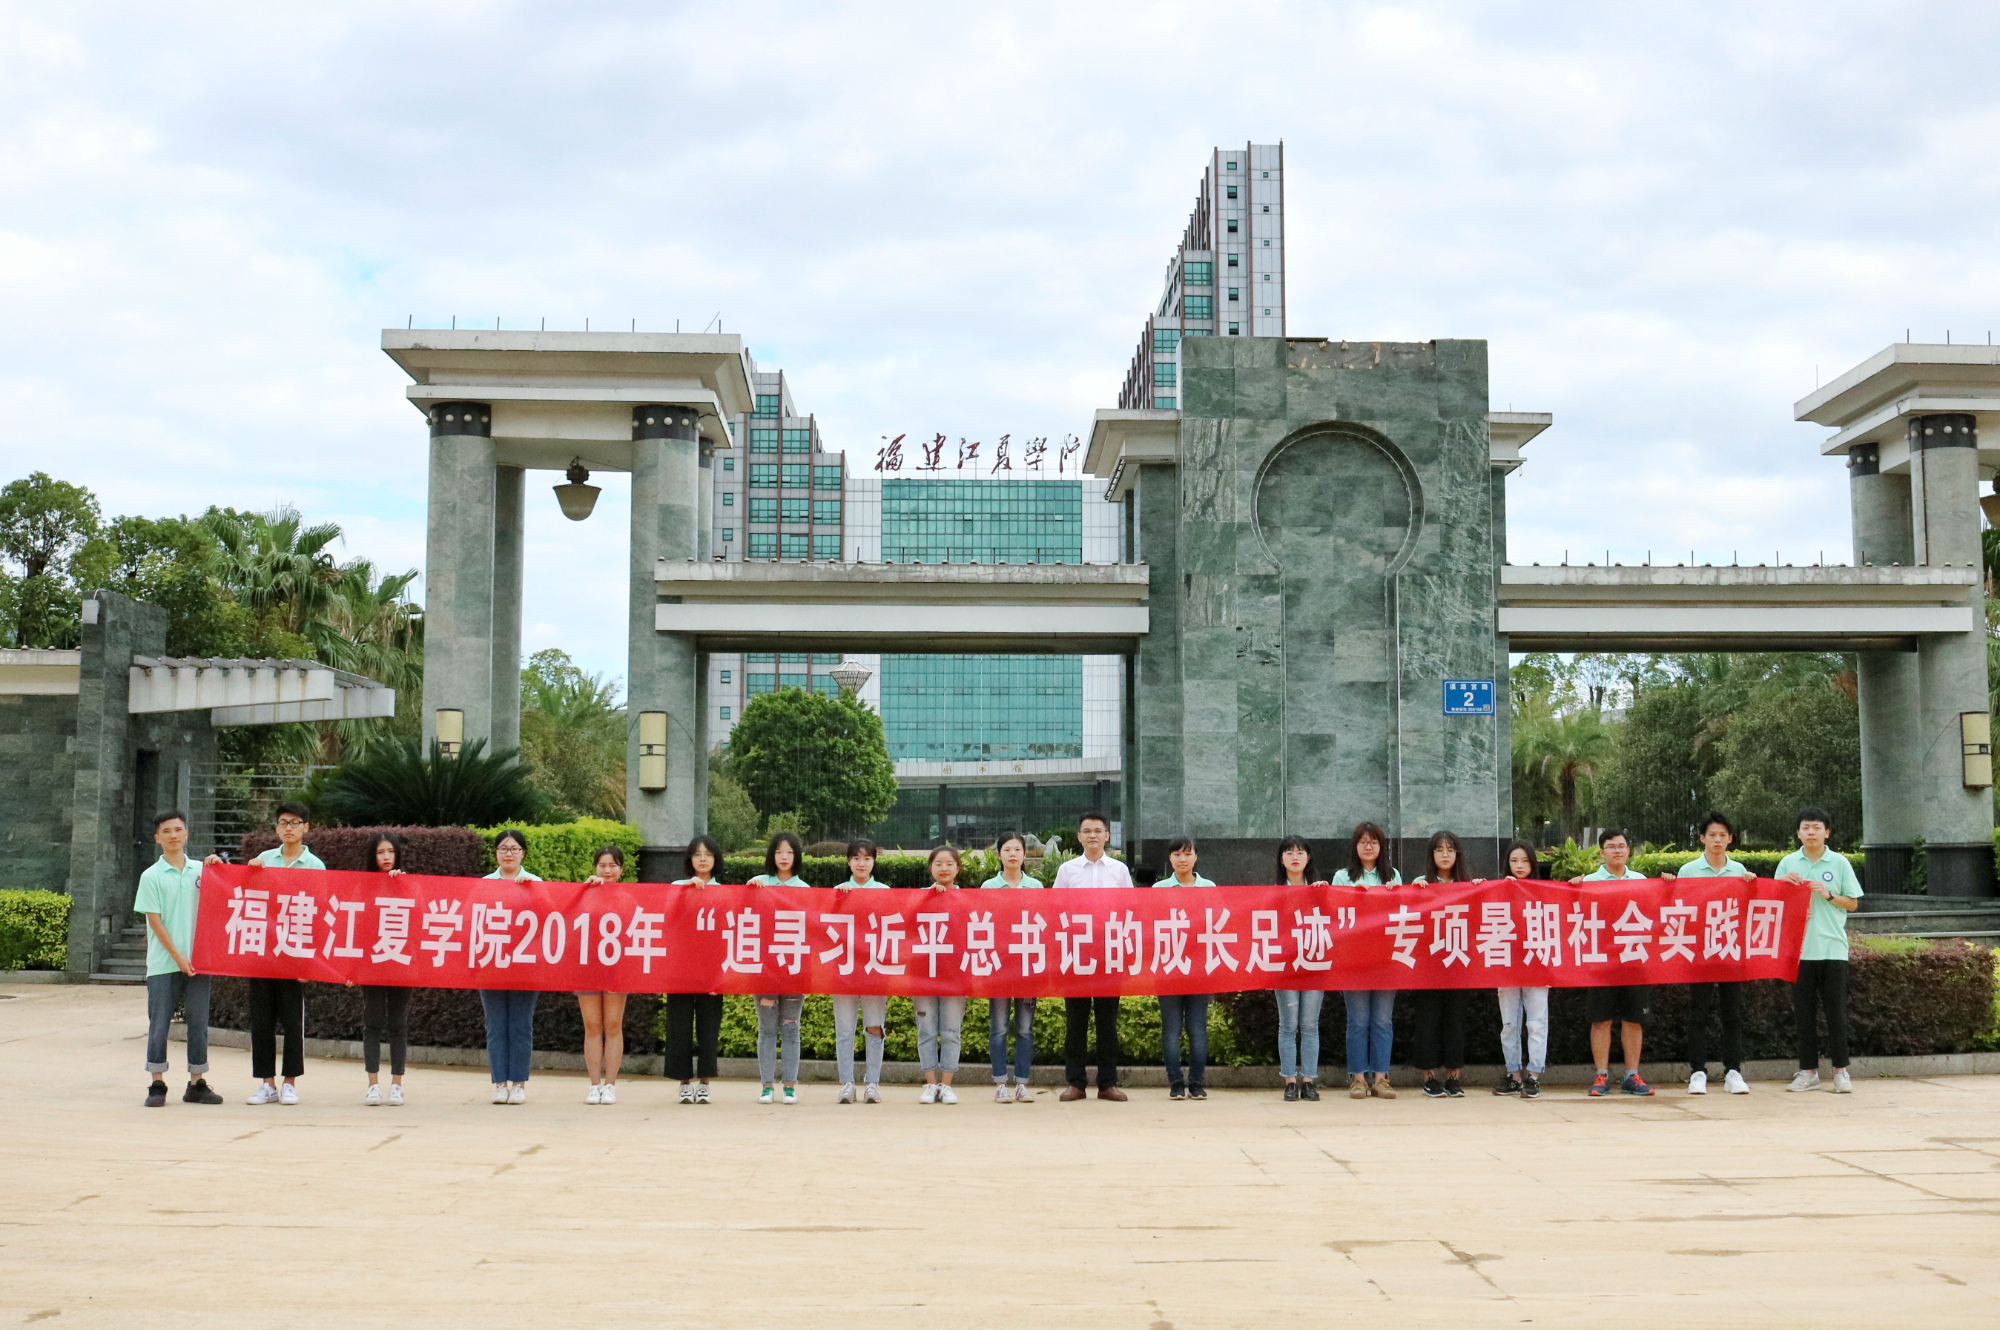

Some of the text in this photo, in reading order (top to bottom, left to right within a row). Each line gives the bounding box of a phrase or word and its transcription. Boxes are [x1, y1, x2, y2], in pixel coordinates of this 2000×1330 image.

[1463, 691, 1474, 707] 2
[224, 885, 667, 975] 福建江夏学院2018年
[1384, 897, 1785, 972] 专项暑期社会实践团
